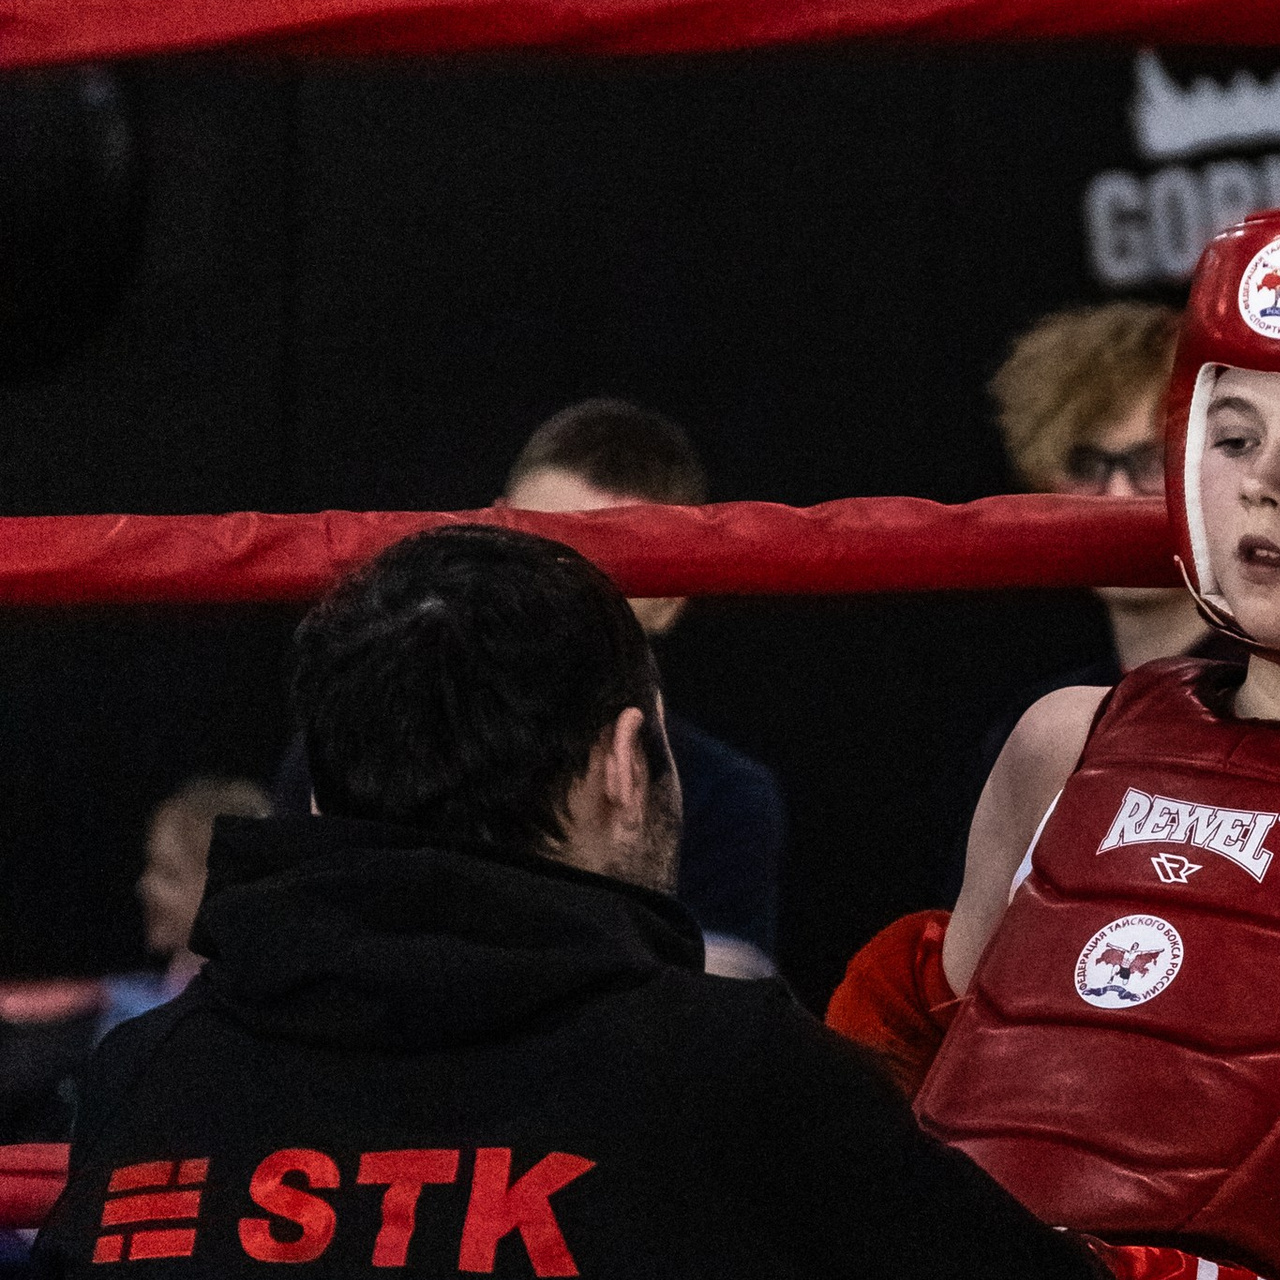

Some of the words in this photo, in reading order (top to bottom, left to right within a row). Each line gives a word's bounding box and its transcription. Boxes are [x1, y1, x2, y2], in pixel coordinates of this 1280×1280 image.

[1243, 256, 1265, 310] ФЕДЕРАЦИЯ
[1107, 917, 1166, 933] ТАЙСКОГО
[1163, 929, 1181, 960] БОКСА
[1077, 931, 1107, 991] ФЕДЕРАЦИЯ
[1142, 962, 1179, 1000] РОССИИ
[238, 1147, 597, 1278] STK
